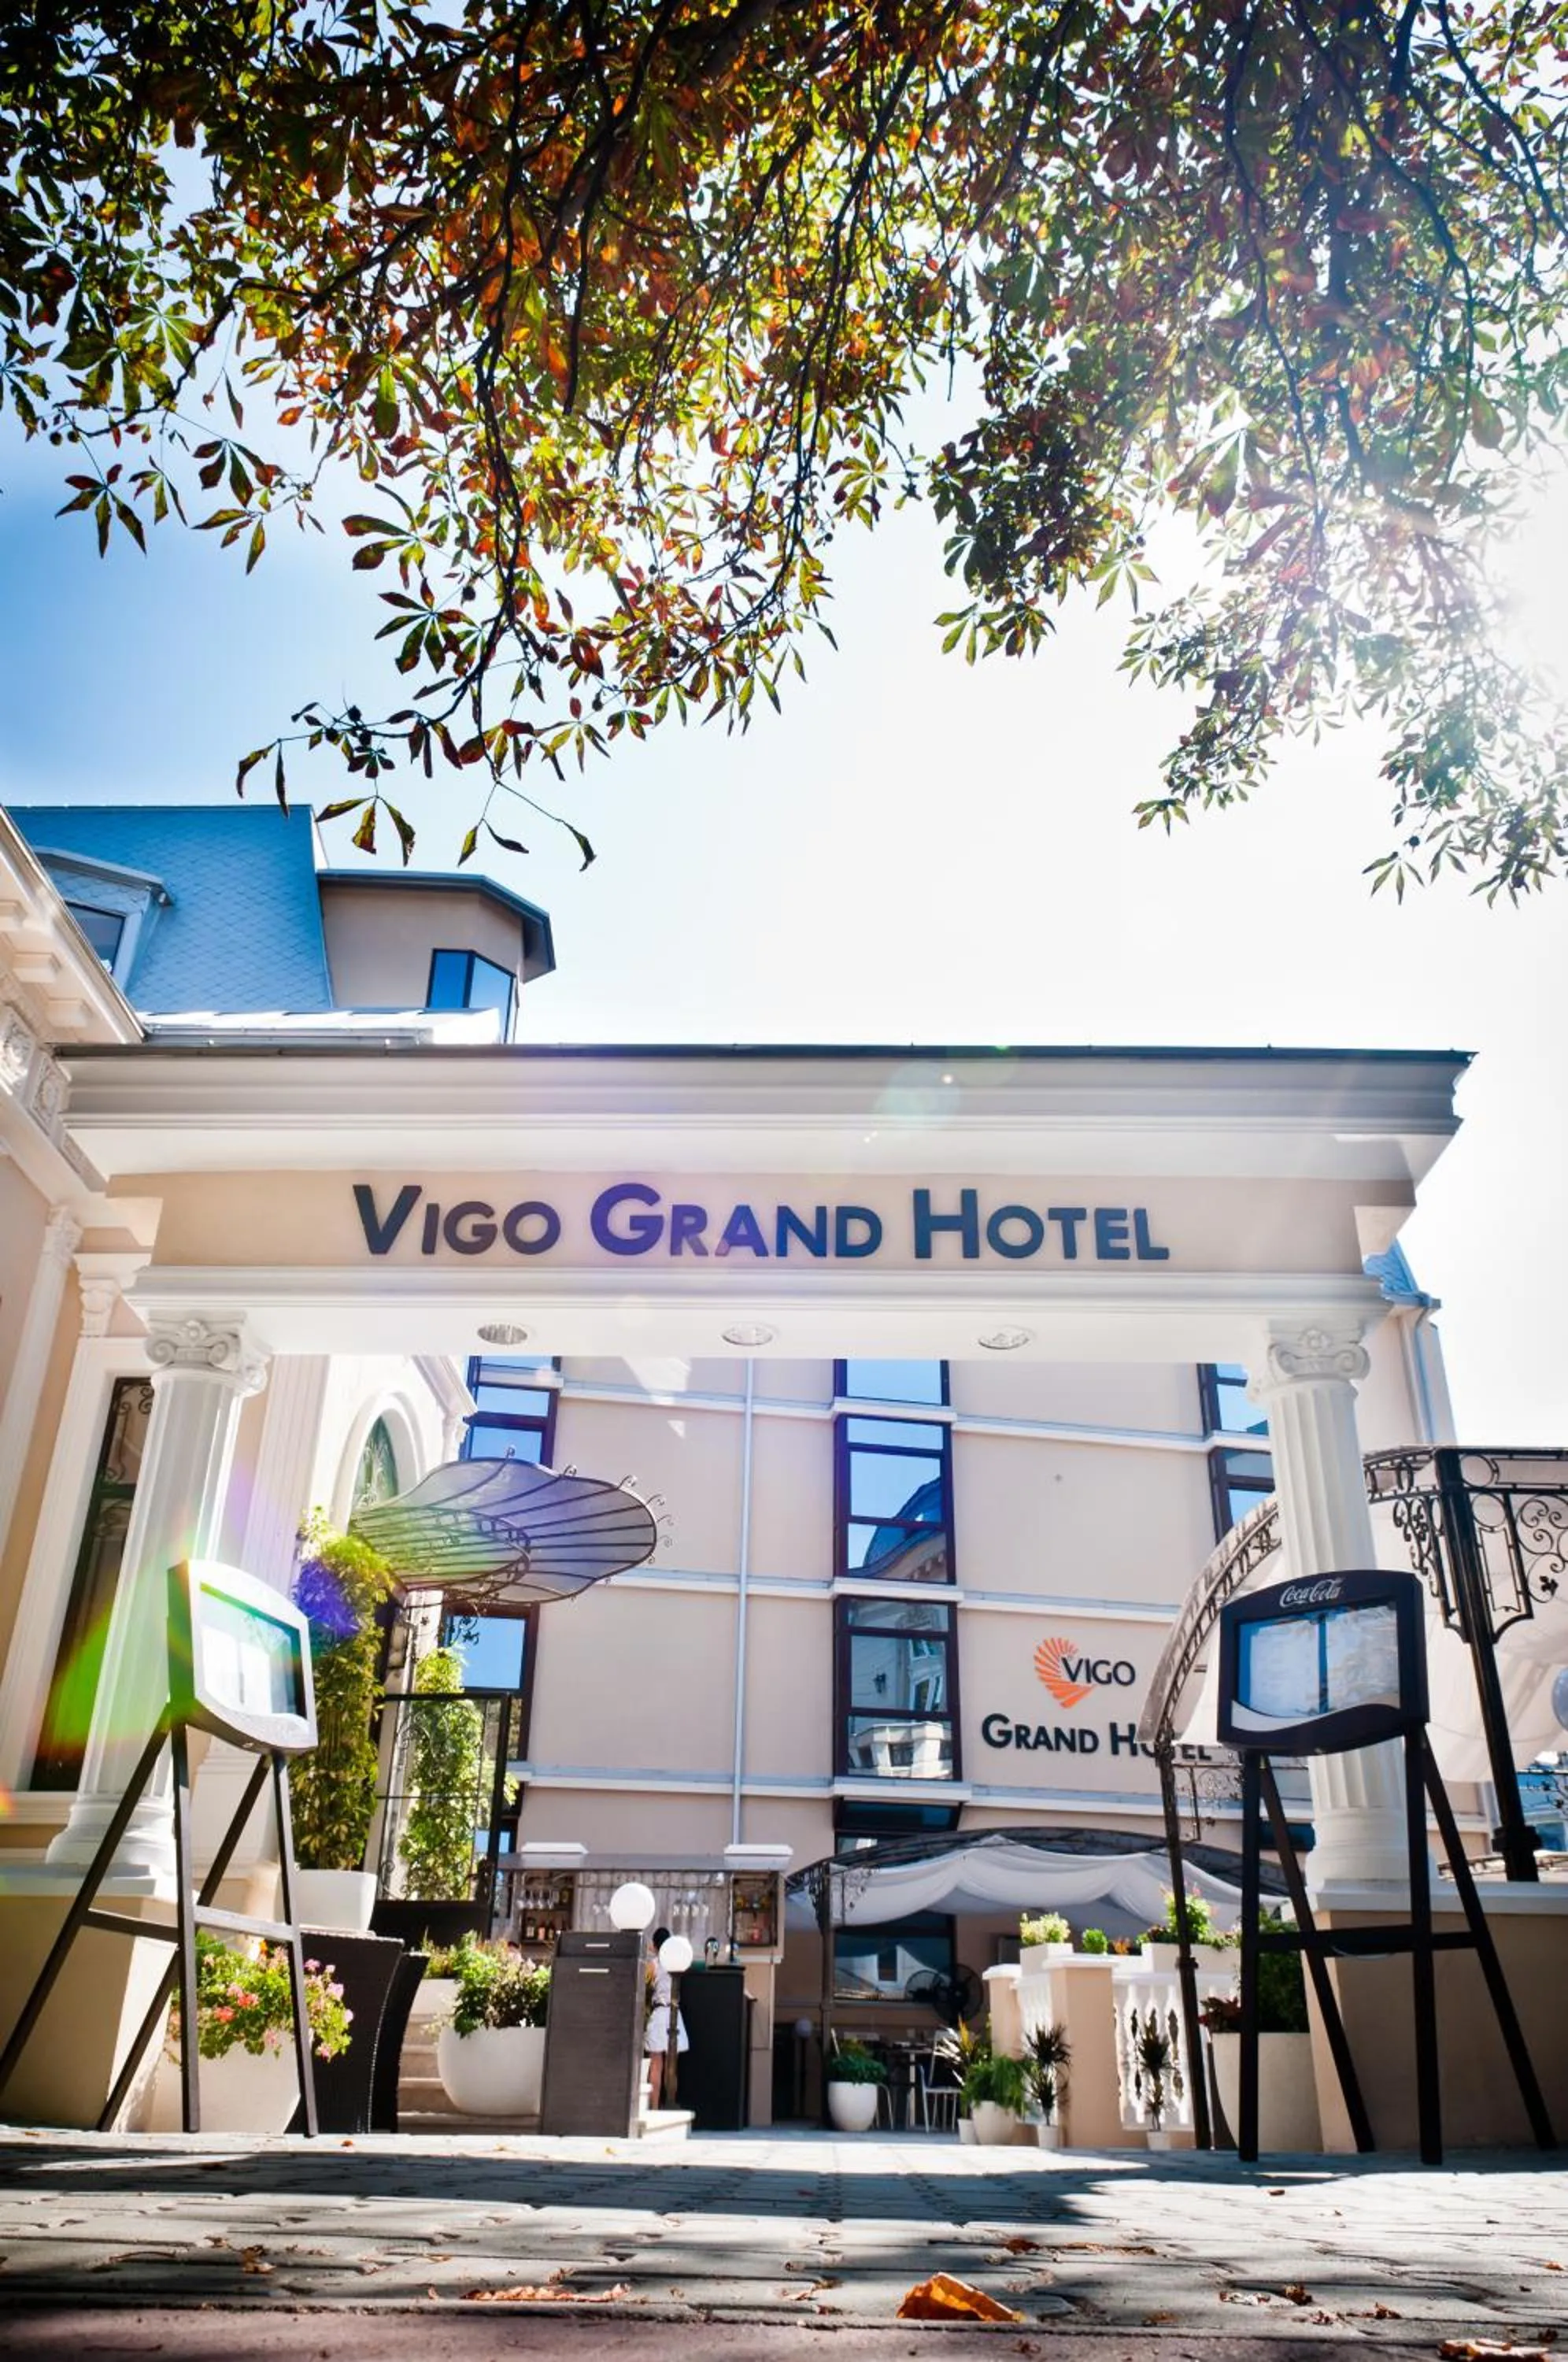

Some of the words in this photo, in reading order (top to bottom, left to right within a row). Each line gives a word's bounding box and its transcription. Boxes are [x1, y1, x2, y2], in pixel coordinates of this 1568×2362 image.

[352, 1183, 561, 1256] VIGO
[590, 1182, 882, 1258] GRAND
[912, 1187, 1170, 1261] HOTEL
[1060, 1657, 1136, 1686] VIGO
[982, 1712, 1100, 1754] GRAND
[1109, 1721, 1212, 1761] HEL
